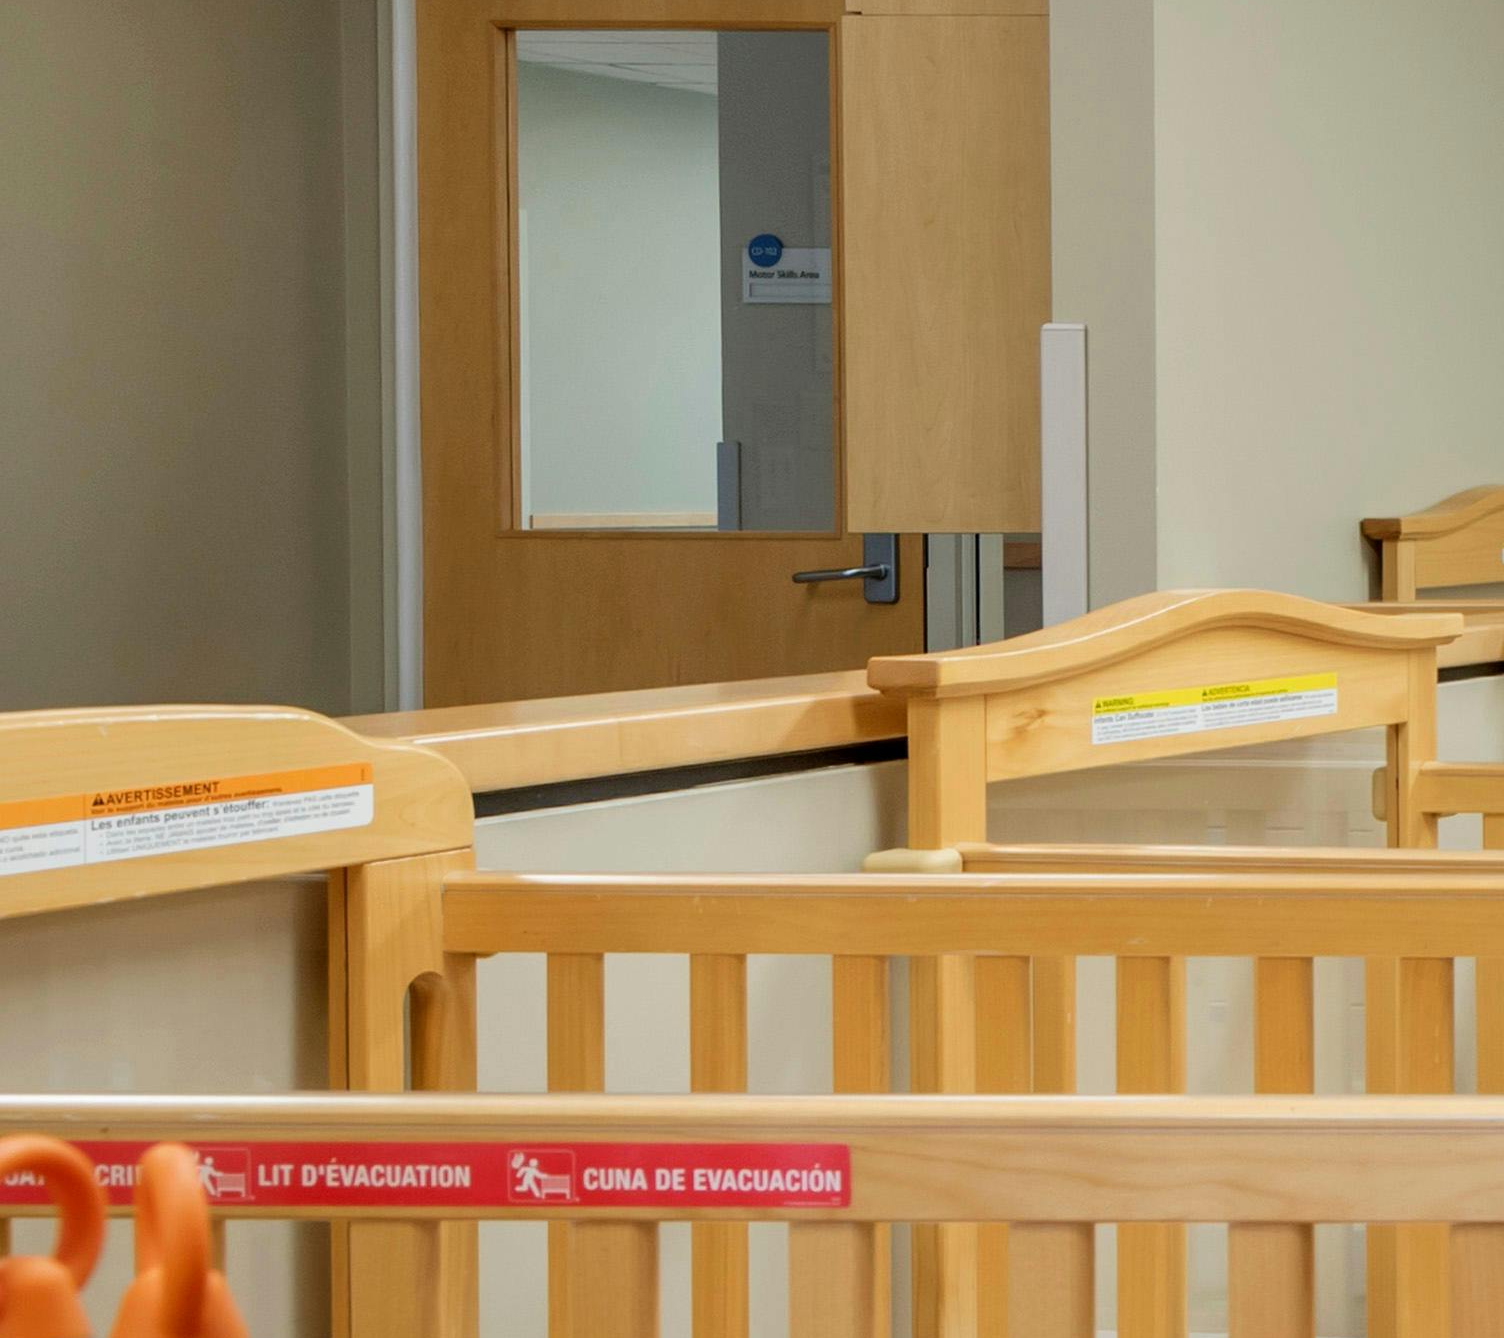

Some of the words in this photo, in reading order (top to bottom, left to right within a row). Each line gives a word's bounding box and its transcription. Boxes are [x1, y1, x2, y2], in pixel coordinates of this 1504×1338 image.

[748, 270, 775, 280] Motor
[777, 270, 798, 280] Skills
[800, 270, 820, 280] Area
[106, 781, 220, 805] AVERTISSEMENT
[91, 819, 112, 831] Les
[116, 812, 160, 829] enfants
[164, 806, 210, 824] peuvent
[94, 1163, 143, 1187] CRI
[257, 1163, 294, 1187] LIT
[301, 1157, 472, 1189] D'ÉVACUATION
[582, 1167, 648, 1192] CUNA
[655, 1167, 686, 1192] DE
[693, 1162, 842, 1193] EVACUACIÓN
